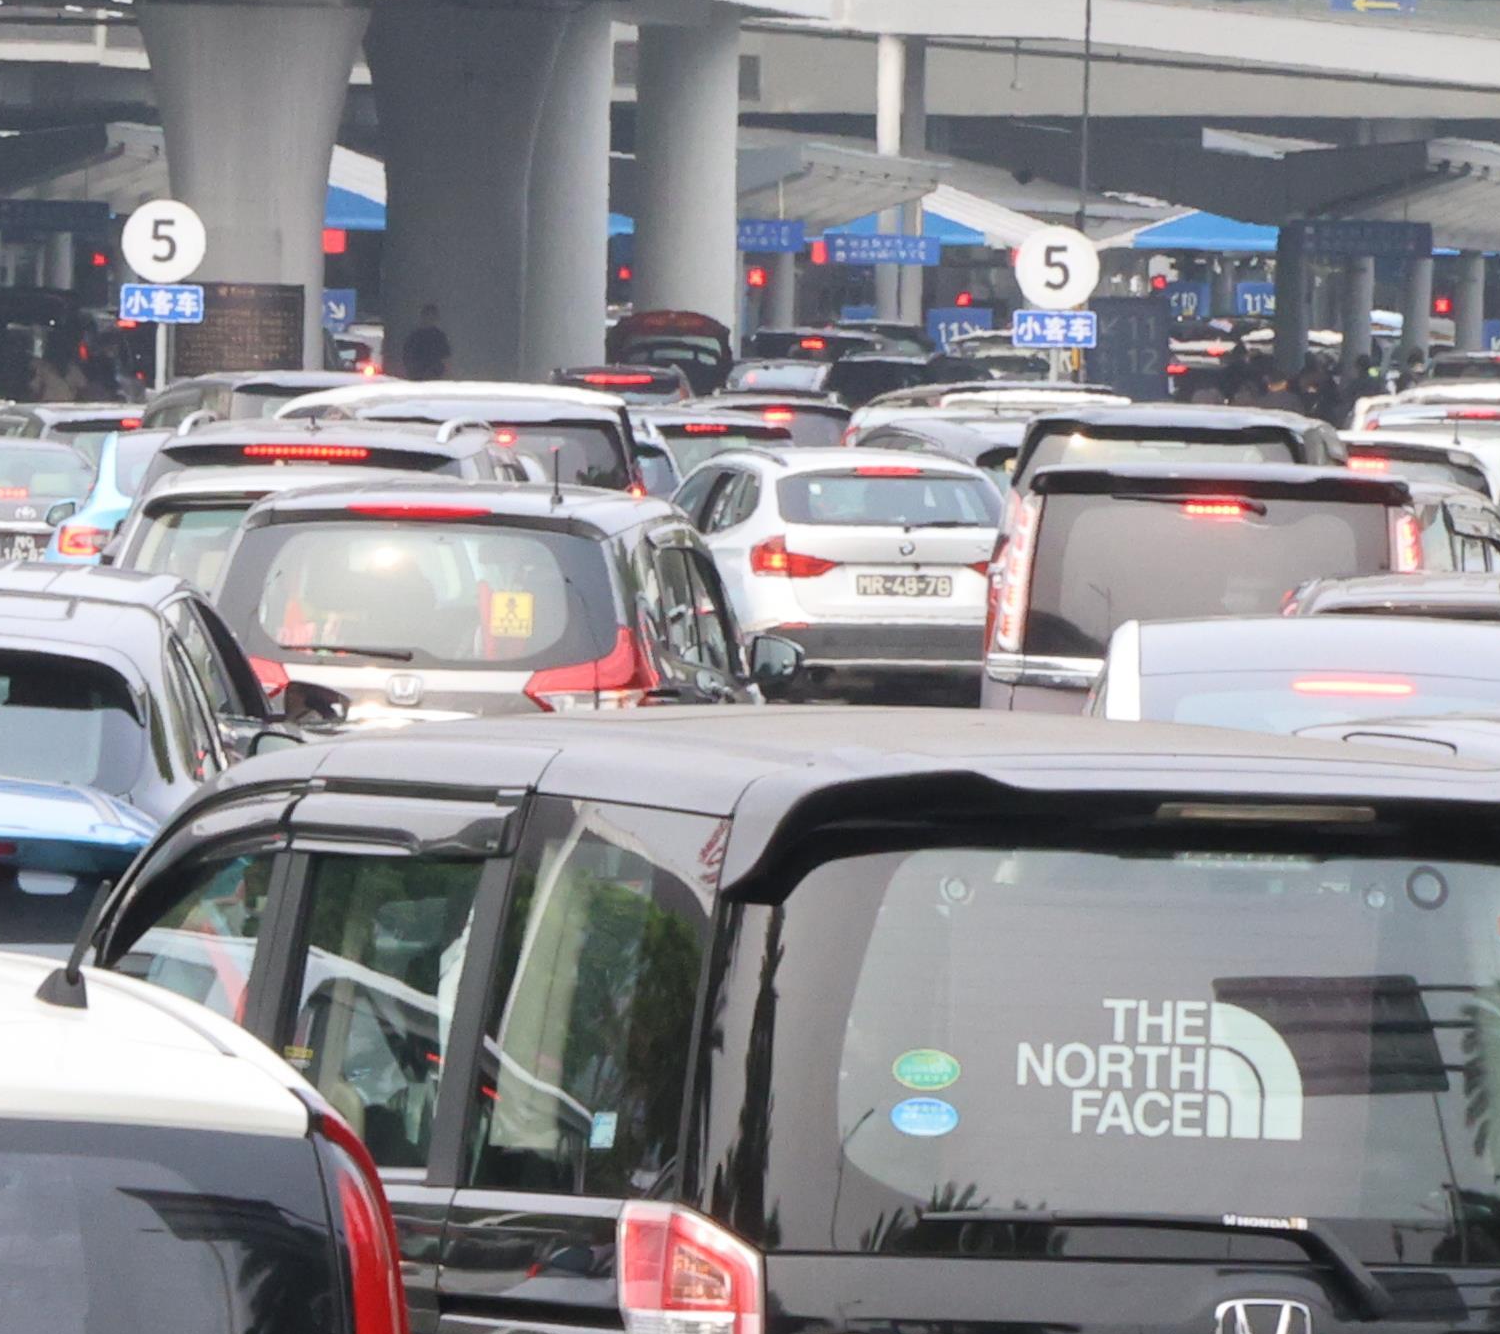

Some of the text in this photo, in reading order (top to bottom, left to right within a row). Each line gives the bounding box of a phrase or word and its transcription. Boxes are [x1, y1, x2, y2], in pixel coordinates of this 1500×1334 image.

[151, 219, 177, 262] 5
[1044, 245, 1070, 290] 5
[126, 290, 199, 317] 小客车
[1017, 318, 1093, 343] 小客车
[1103, 998, 1208, 1045] THE
[1016, 1041, 1205, 1091] NORTH
[1071, 1090, 1204, 1137] FACE
[1236, 1216, 1290, 1230] HONDA
